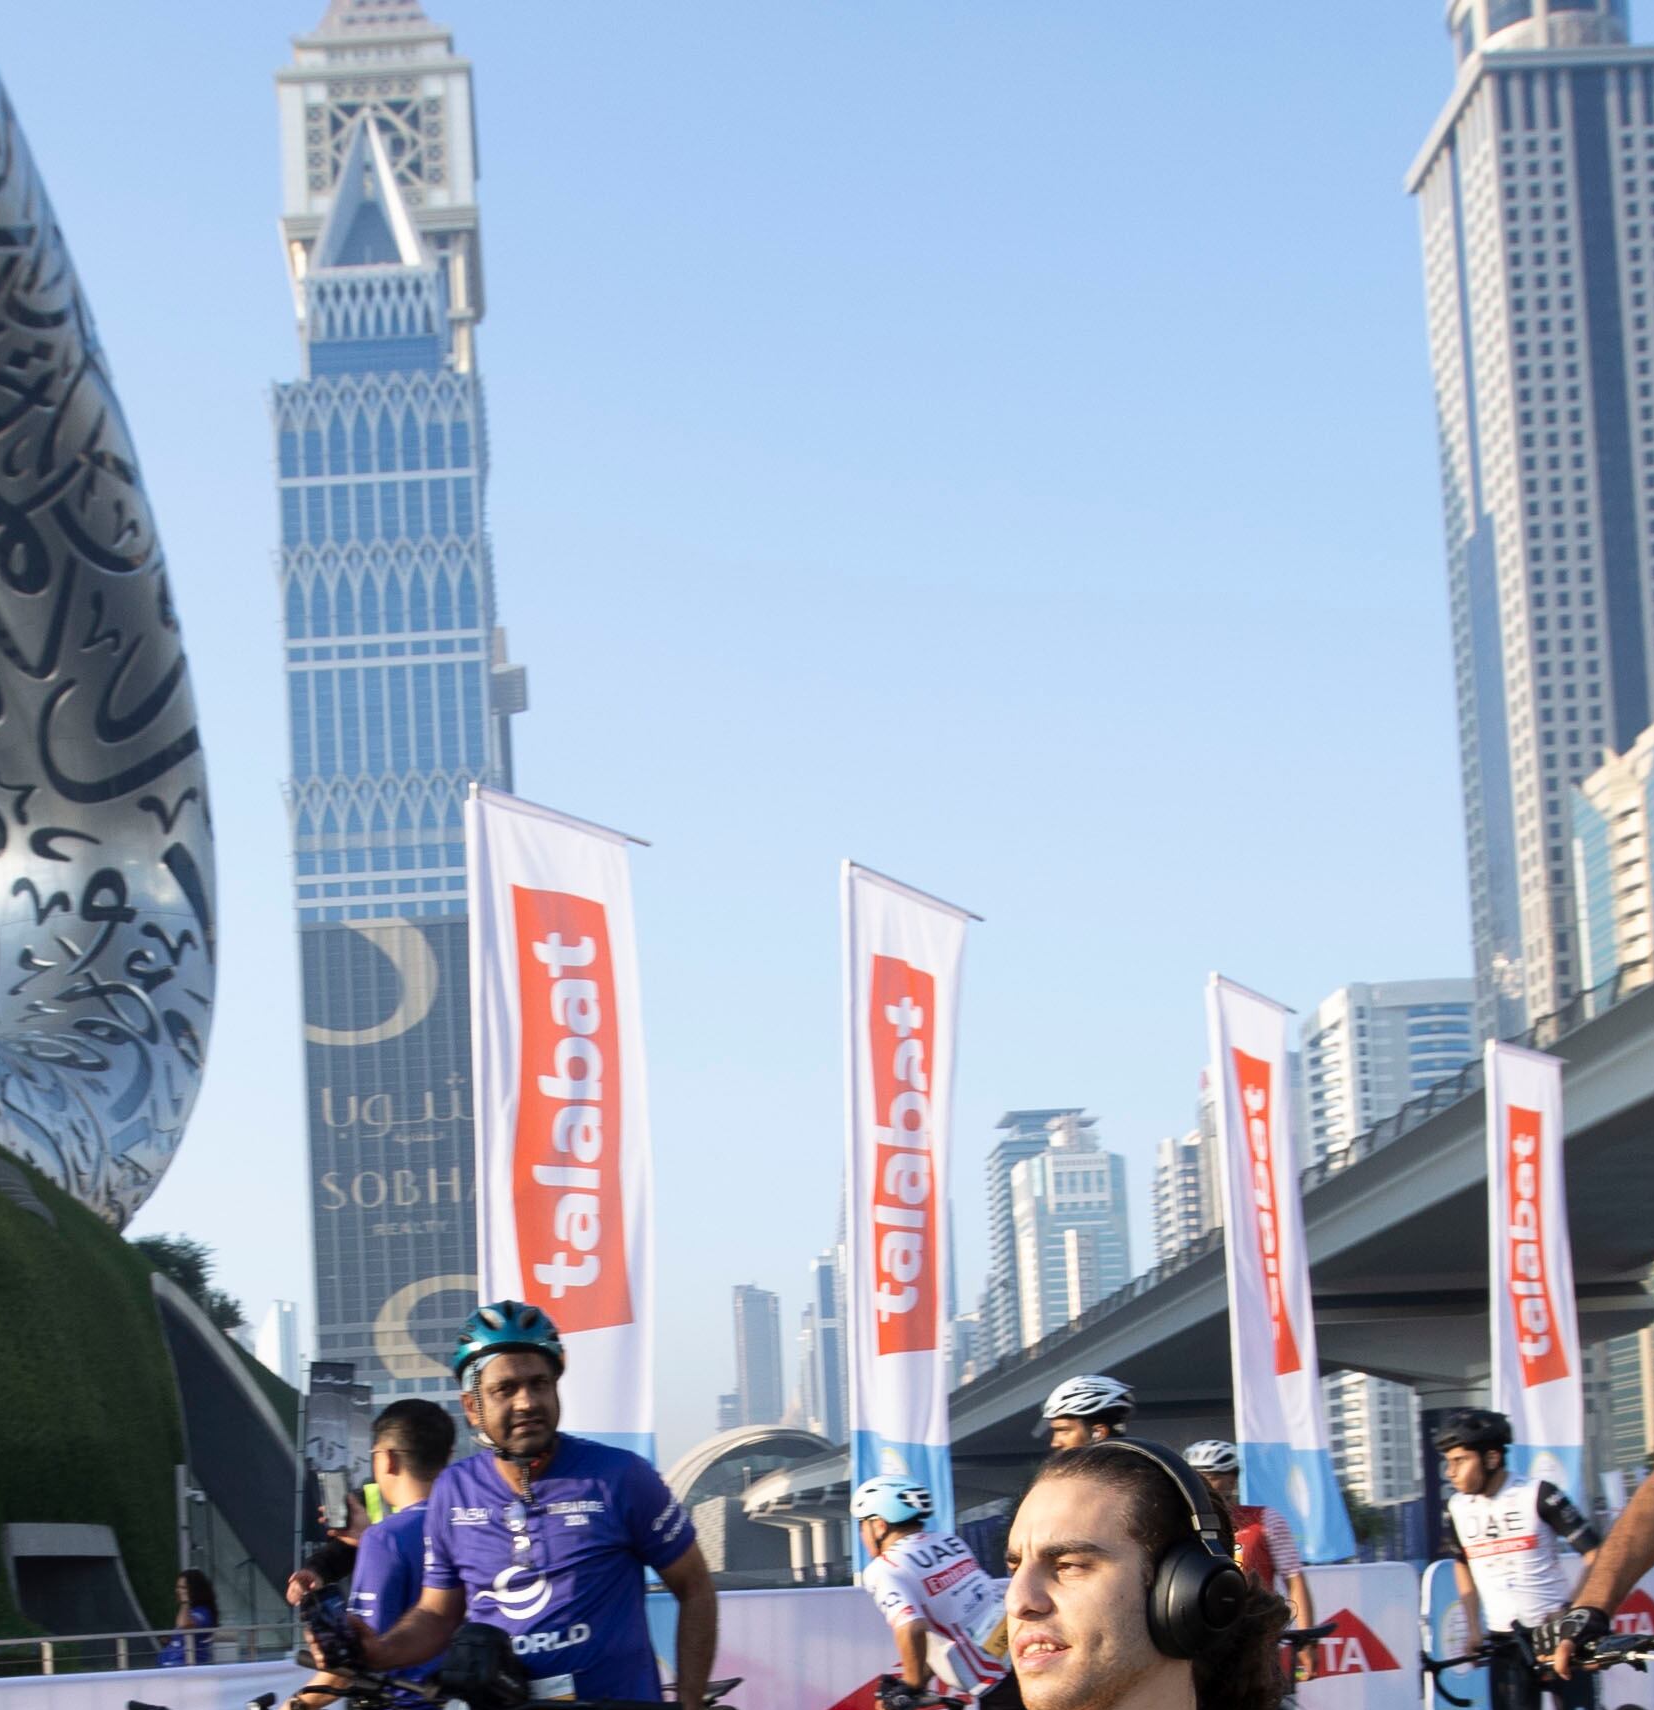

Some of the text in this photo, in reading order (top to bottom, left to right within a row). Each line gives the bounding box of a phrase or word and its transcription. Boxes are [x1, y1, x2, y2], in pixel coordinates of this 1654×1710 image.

[532, 931, 603, 1299] talabat
[321, 1166, 477, 1210] SOBH
[1509, 1132, 1552, 1364] talabat
[907, 1536, 966, 1569] UAE
[509, 1623, 591, 1656] ORLD
[1318, 1636, 1373, 1673] TA
